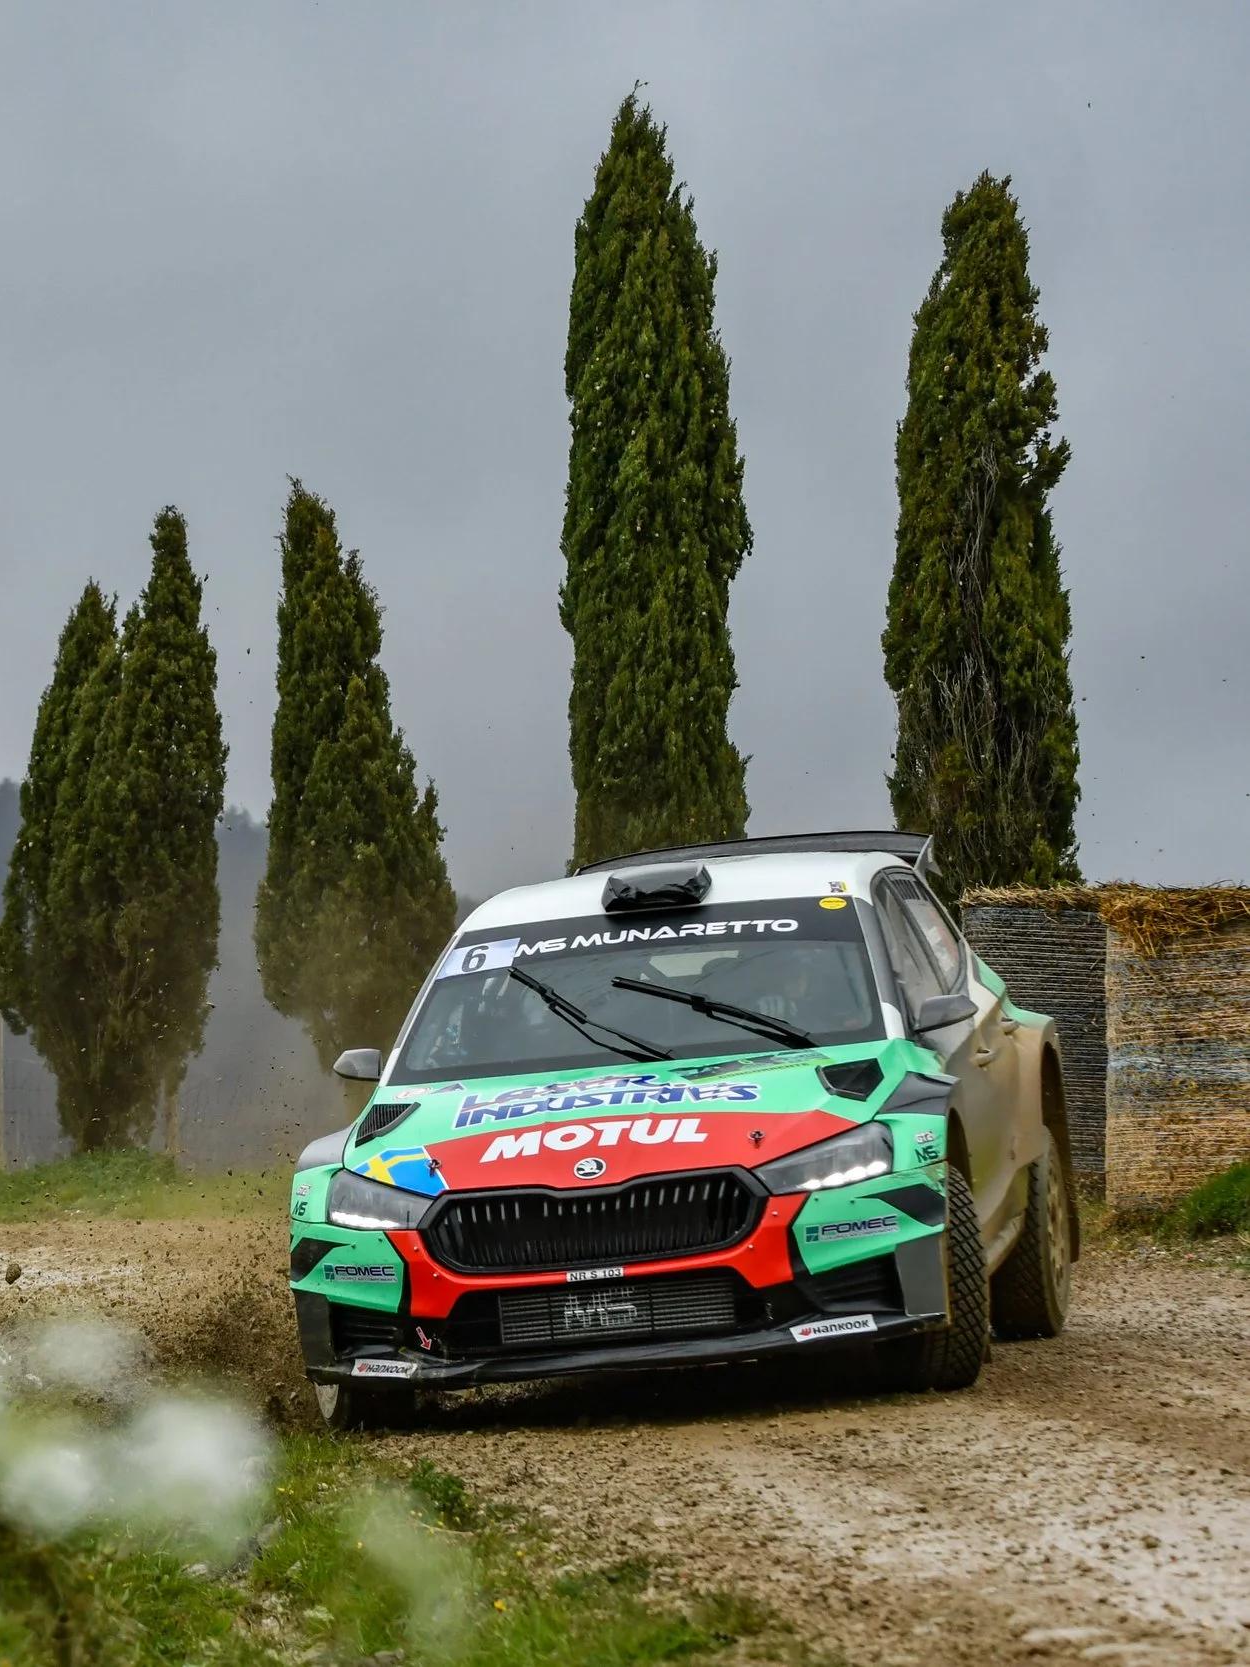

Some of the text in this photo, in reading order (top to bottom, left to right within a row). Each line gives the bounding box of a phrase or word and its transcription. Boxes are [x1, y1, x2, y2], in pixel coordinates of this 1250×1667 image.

[514, 919, 799, 958] MS MUNARETTO
[461, 945, 489, 973] 6
[479, 1118, 708, 1163] MOTUL
[821, 1215, 897, 1235] FOMEC
[334, 1265, 395, 1277] FOMEC
[570, 1268, 621, 1281] NR S 103
